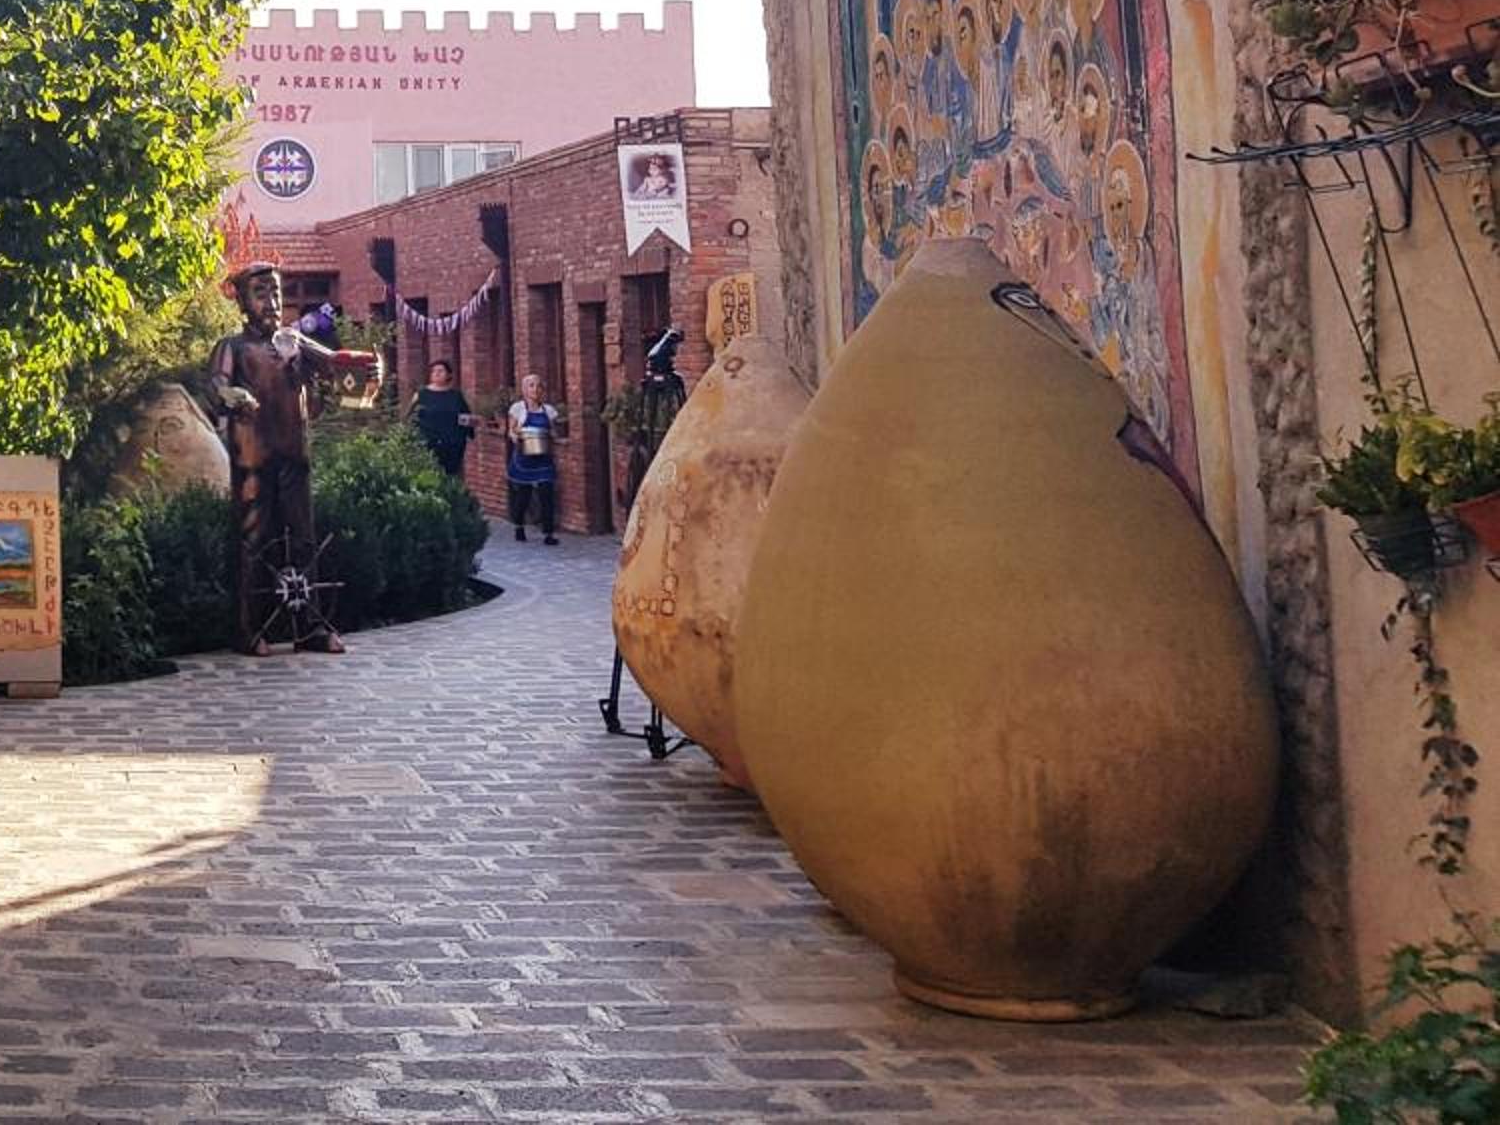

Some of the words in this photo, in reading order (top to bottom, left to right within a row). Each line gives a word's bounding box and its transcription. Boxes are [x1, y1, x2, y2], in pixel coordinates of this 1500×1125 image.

[413, 46, 466, 65] ԽԱՉ
[278, 76, 382, 89] ARMENIAN
[399, 77, 464, 91] UNITY
[257, 104, 312, 124] 1987
